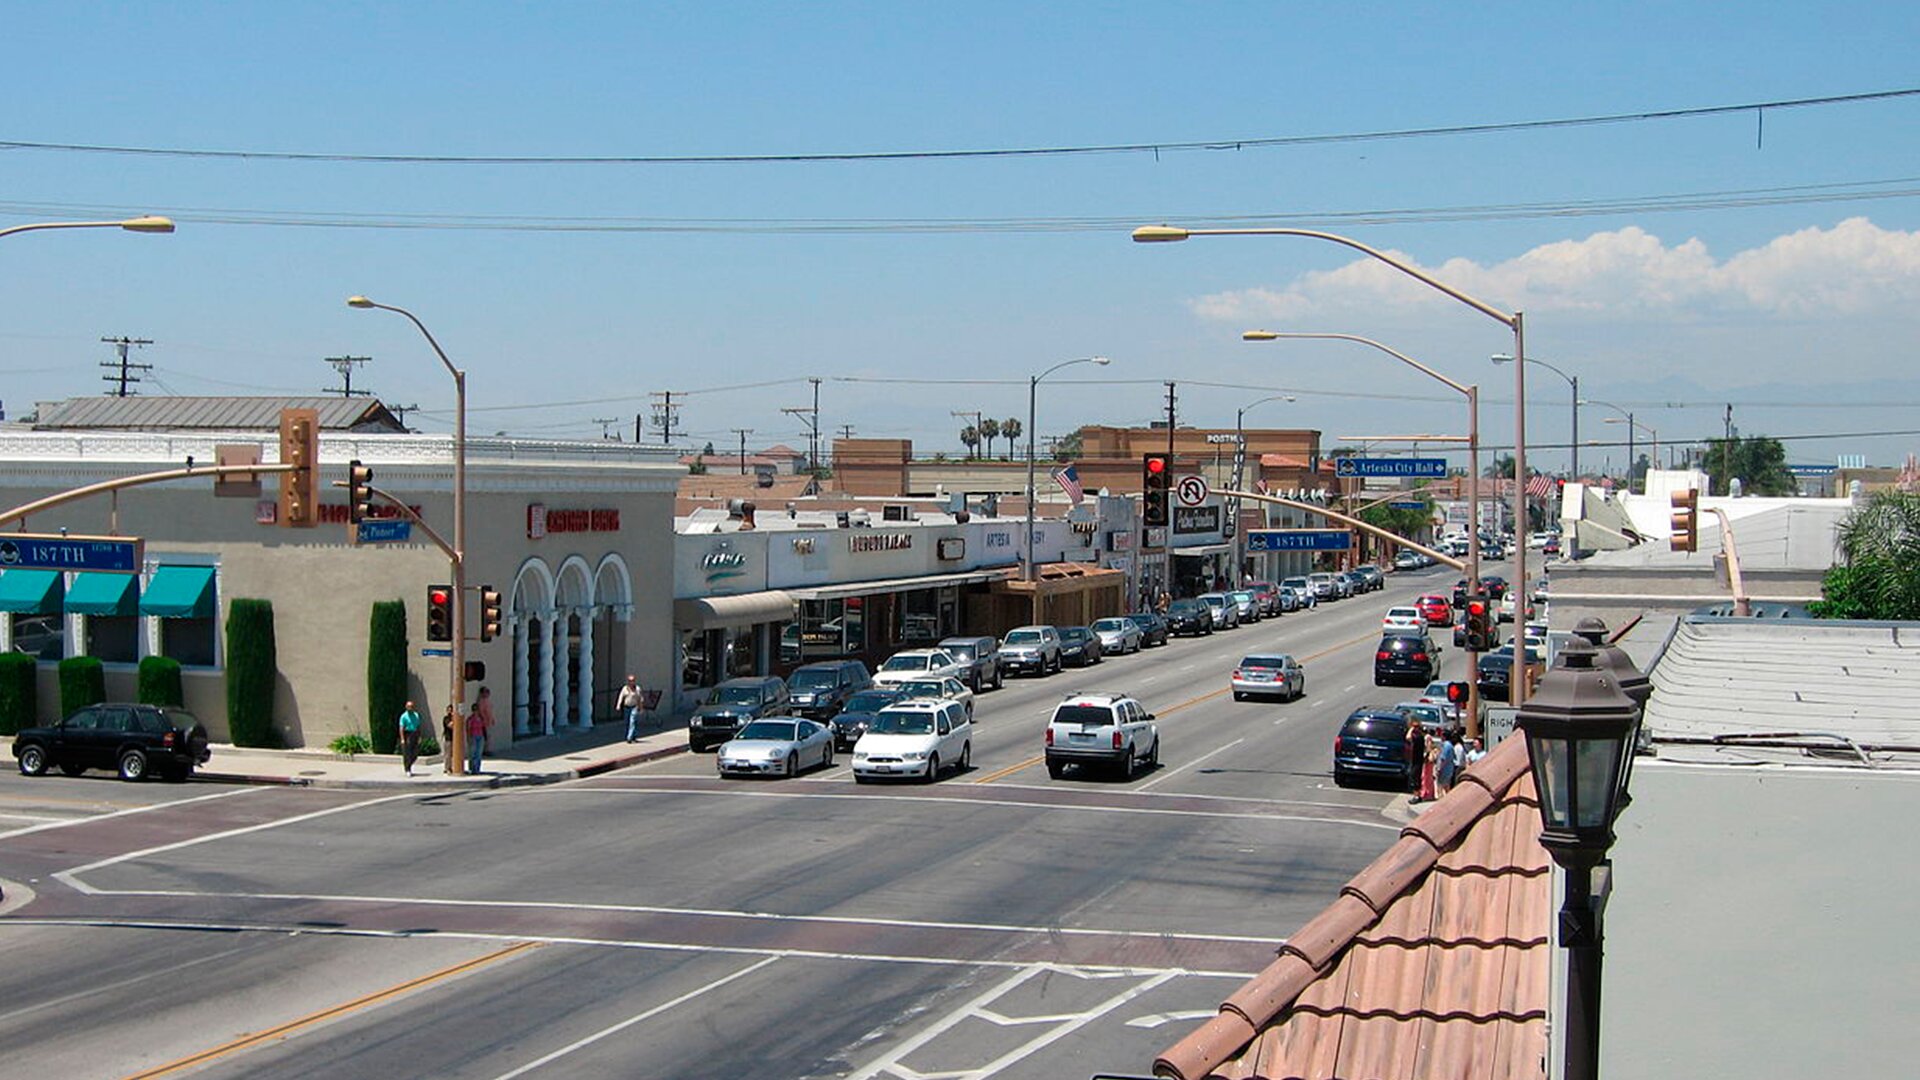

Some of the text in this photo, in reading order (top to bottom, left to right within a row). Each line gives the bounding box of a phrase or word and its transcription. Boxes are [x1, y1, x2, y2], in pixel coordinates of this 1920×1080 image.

[1360, 463, 1434, 474] Artesia City Hall
[1275, 535, 1316, 548] 187TH
[32, 546, 85, 563] 187TH
[1489, 718, 1514, 728] RIGH
